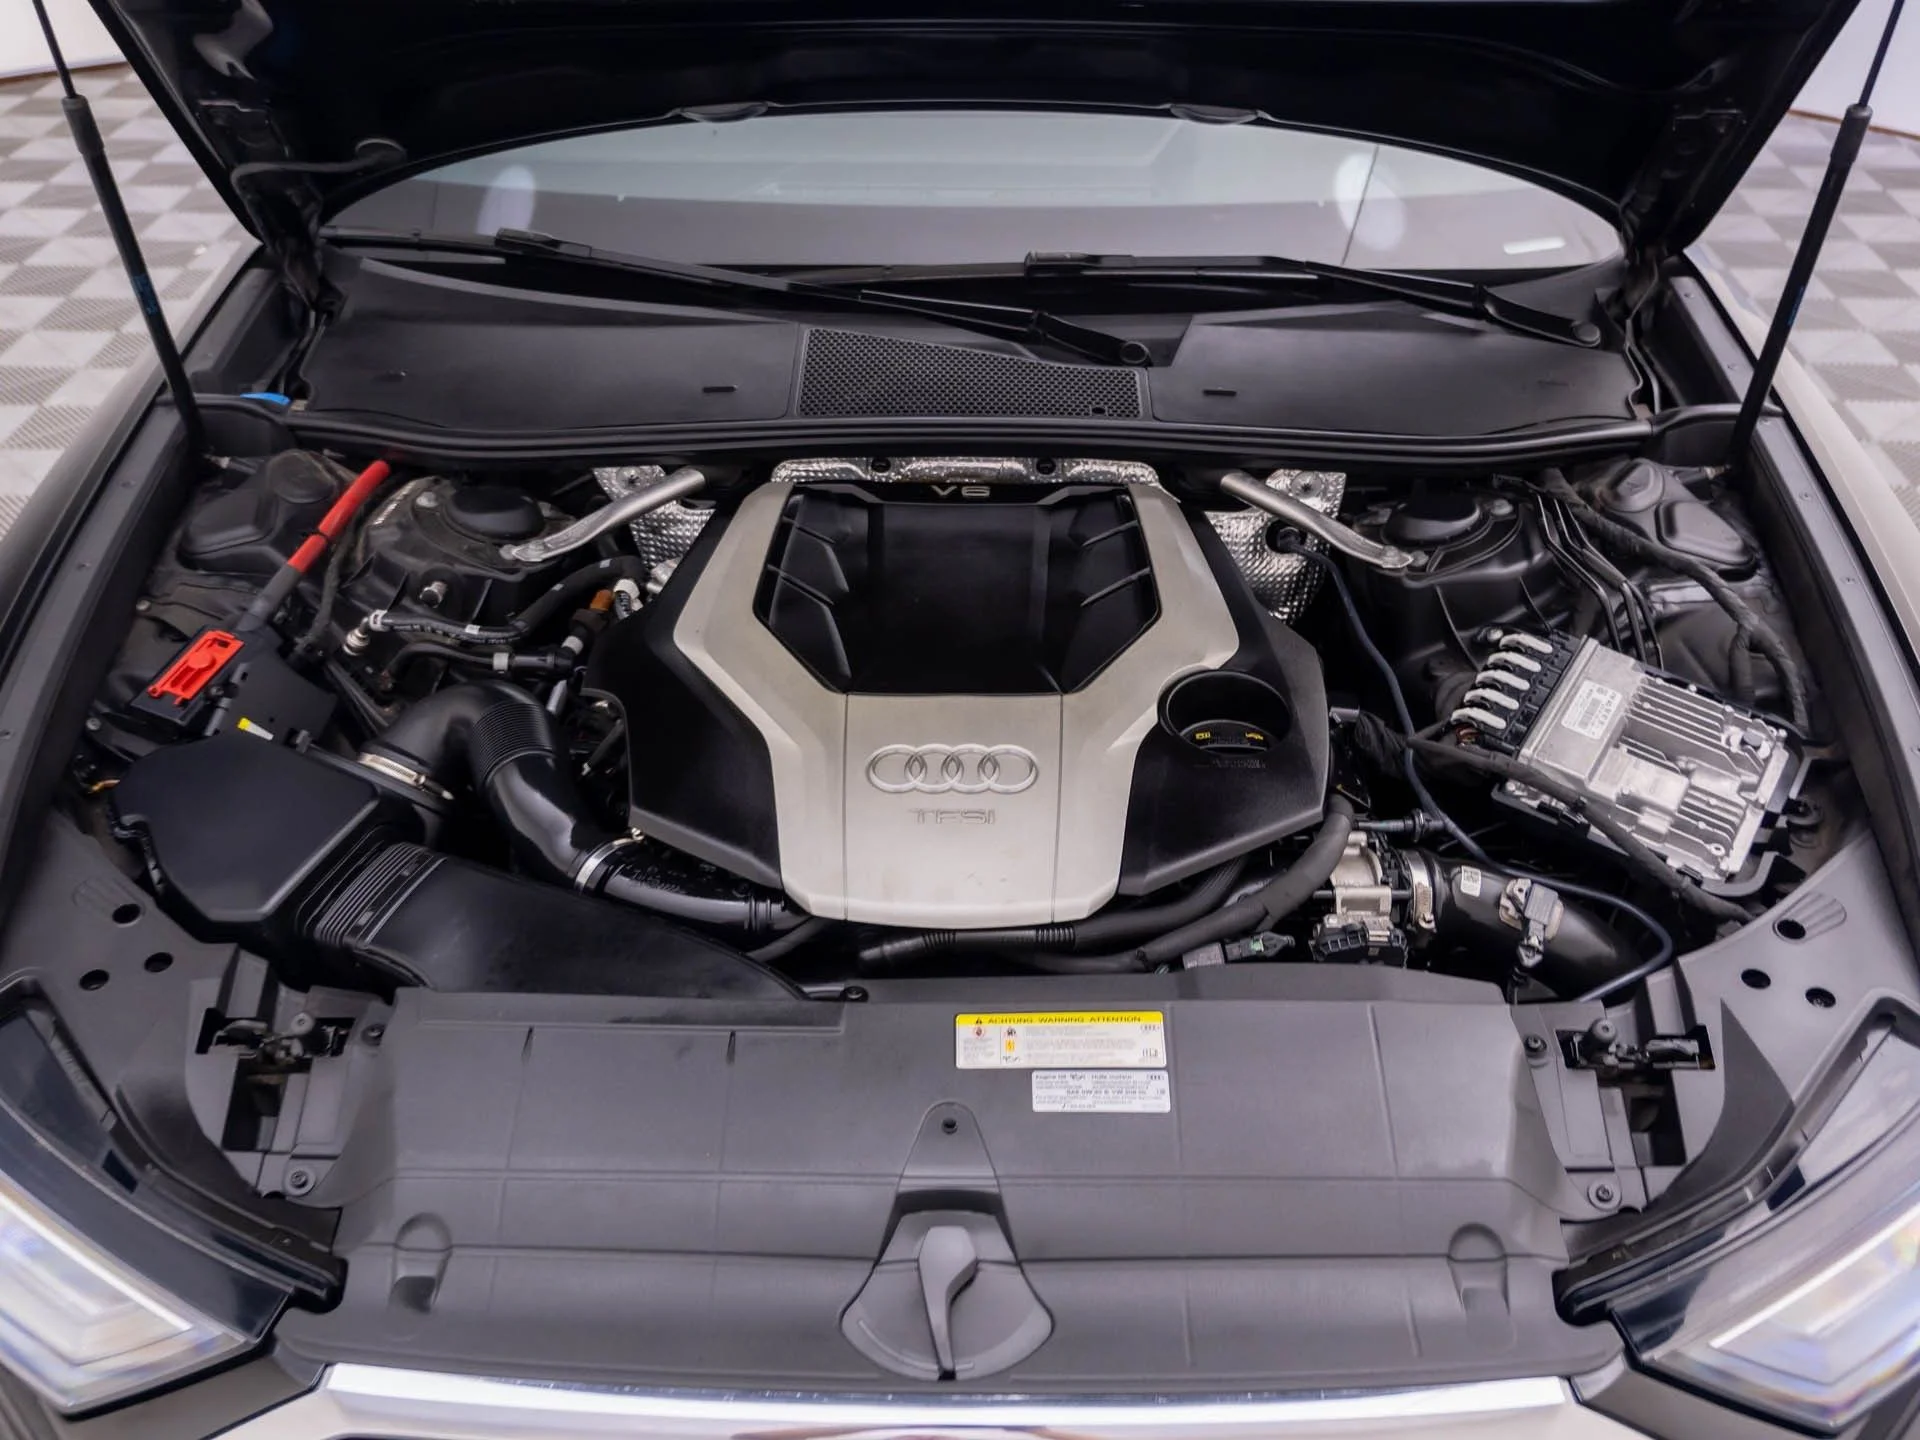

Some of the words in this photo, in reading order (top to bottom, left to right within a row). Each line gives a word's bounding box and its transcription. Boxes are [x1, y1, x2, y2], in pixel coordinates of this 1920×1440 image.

[931, 485, 991, 497] V6
[909, 808, 996, 824] TFSI
[1038, 1016, 1084, 1024] WARNING
[1089, 1015, 1142, 1023] ATTENTION
